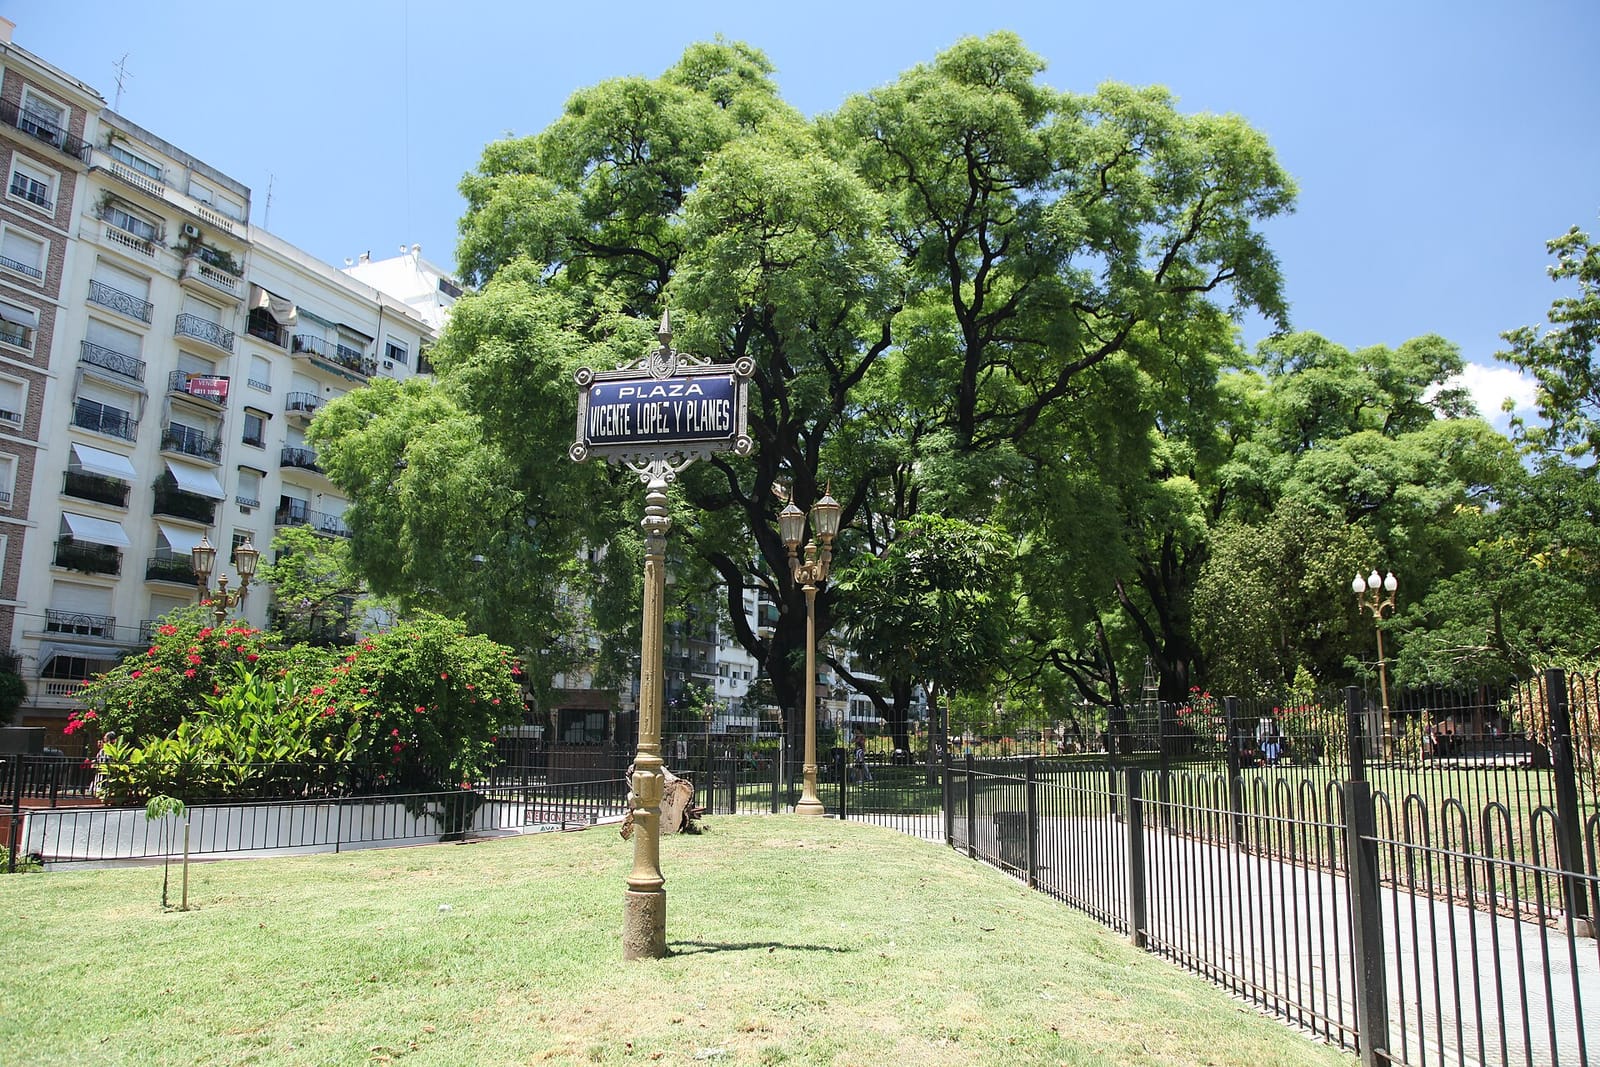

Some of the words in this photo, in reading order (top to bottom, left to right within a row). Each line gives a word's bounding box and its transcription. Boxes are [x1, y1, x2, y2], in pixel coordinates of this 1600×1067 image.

[618, 384, 704, 399] PLAZA
[590, 403, 631, 437] VICENTE
[673, 401, 683, 433] Y
[686, 399, 730, 433] PLANES
